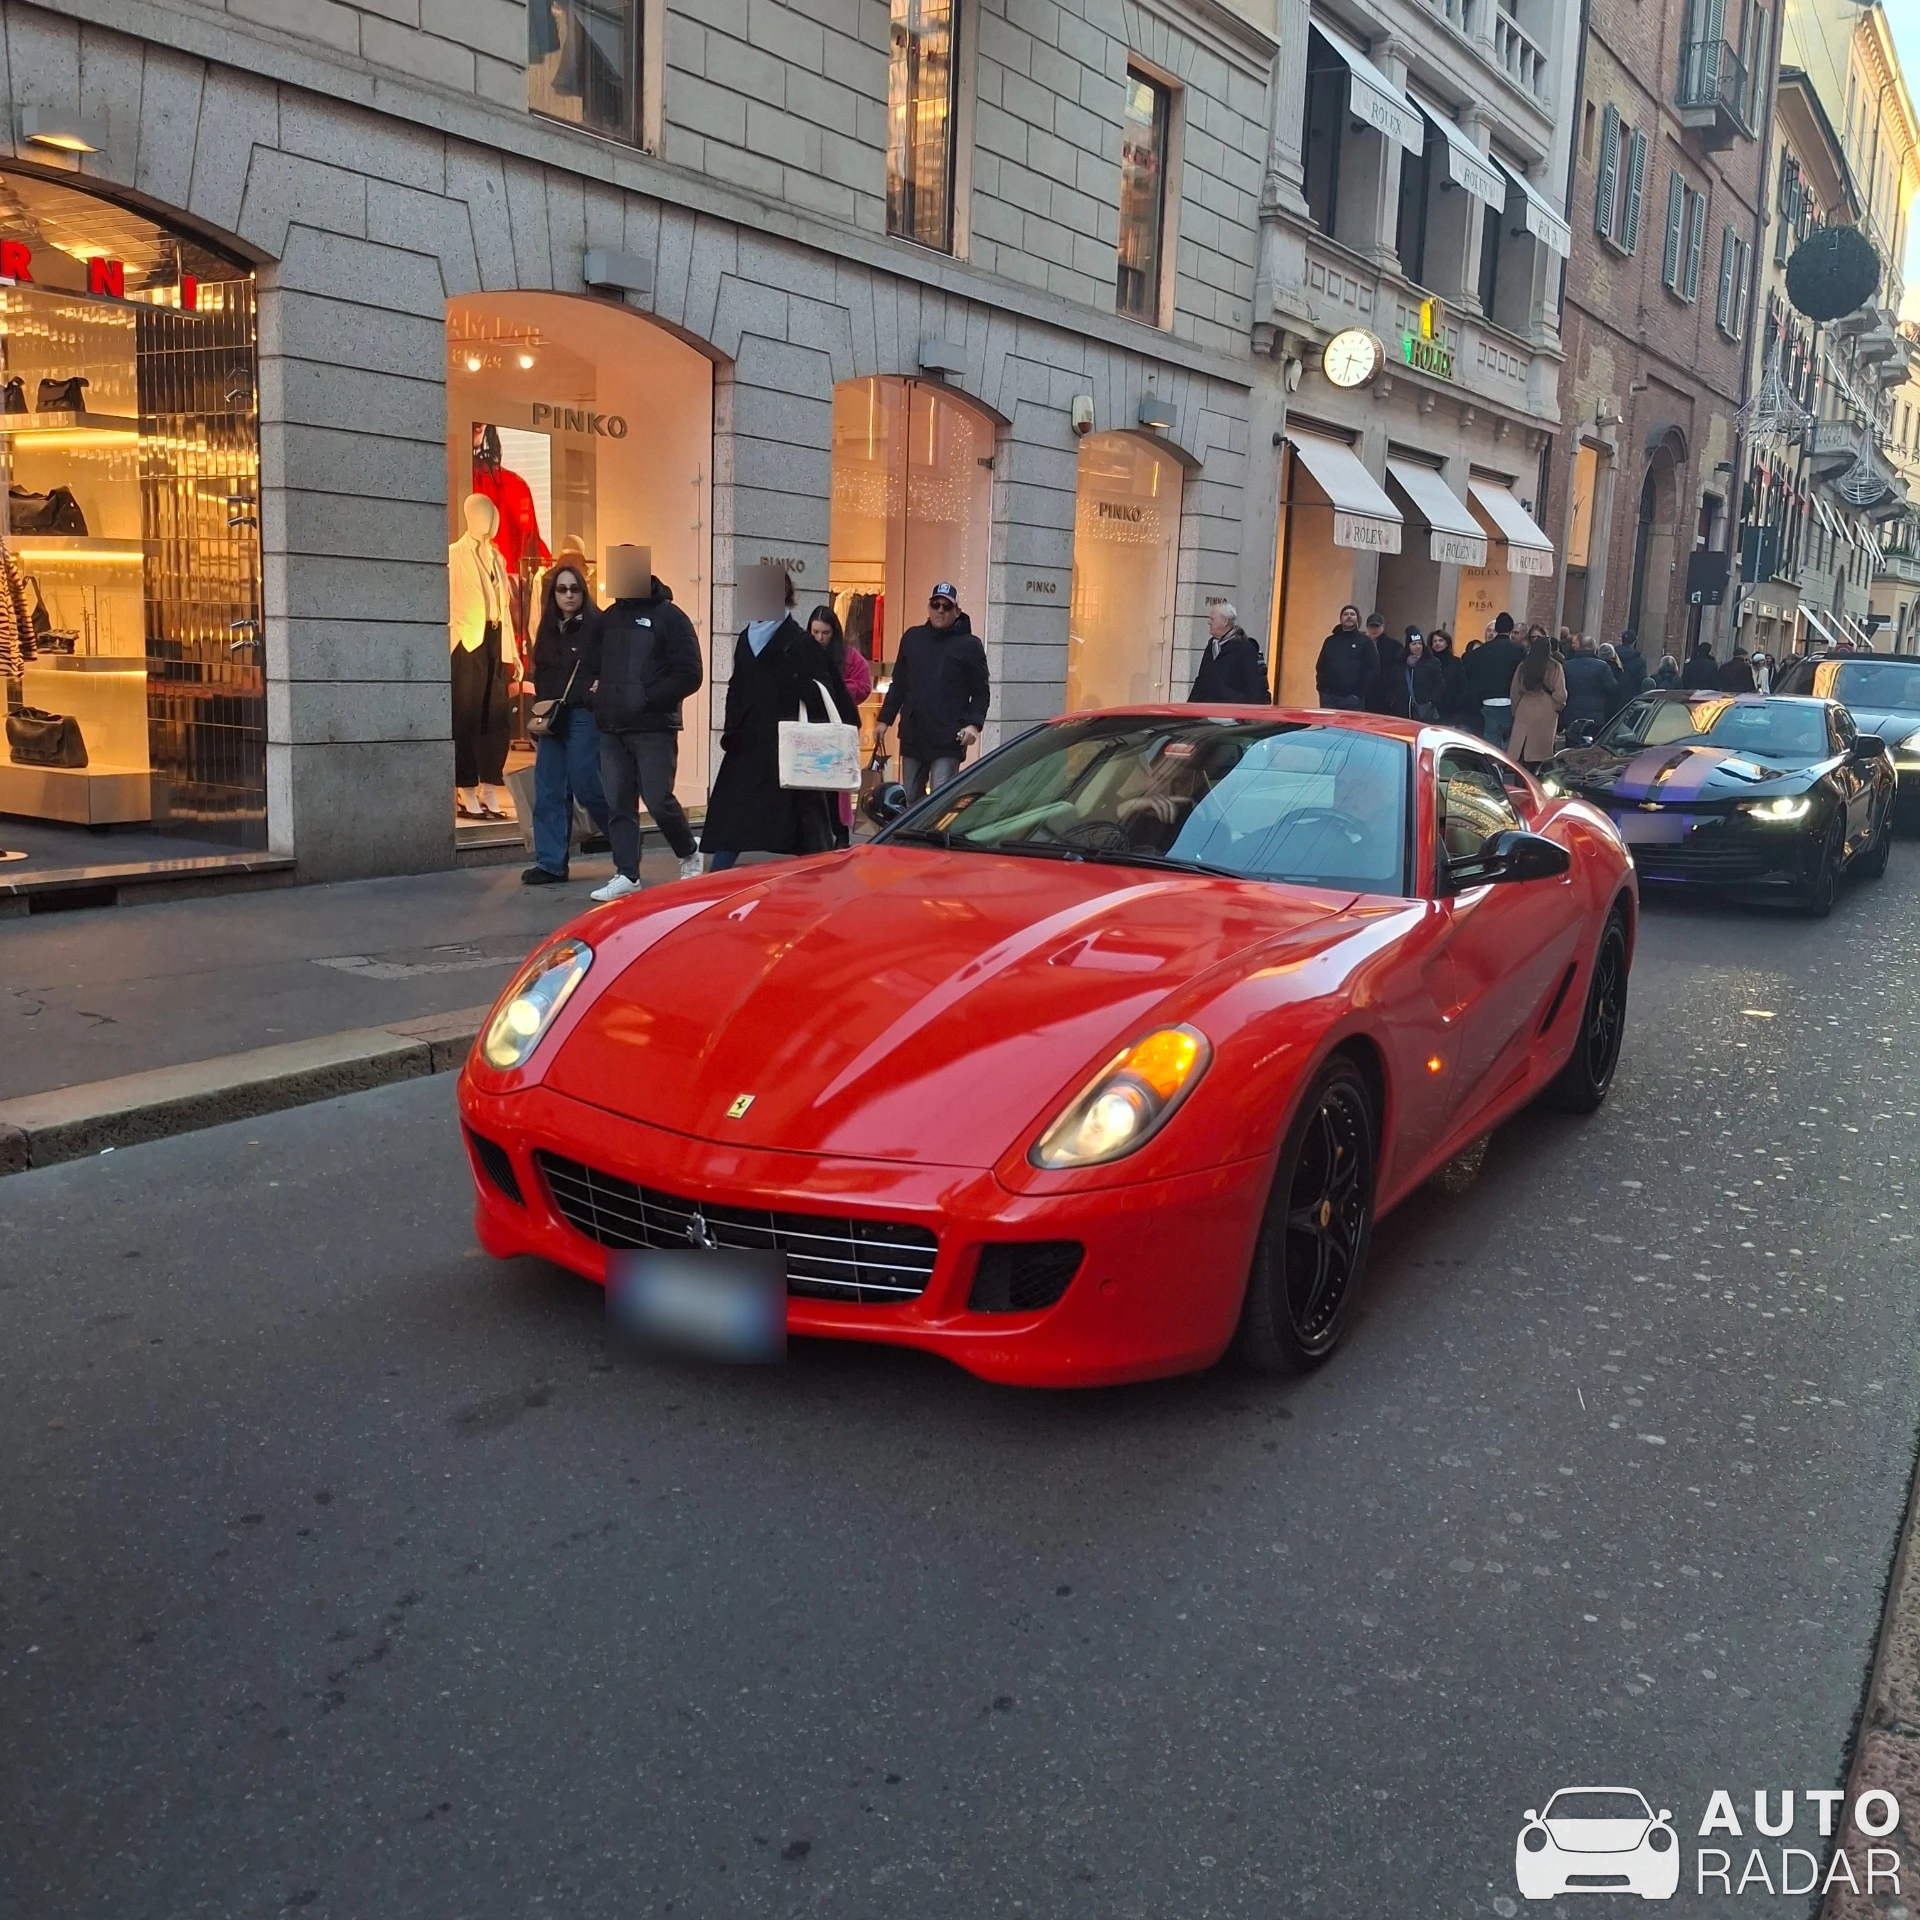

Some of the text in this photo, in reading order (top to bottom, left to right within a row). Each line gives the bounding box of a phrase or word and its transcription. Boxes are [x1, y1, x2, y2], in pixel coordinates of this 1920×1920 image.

[1371, 102, 1402, 134] ROLEX
[1464, 167, 1489, 196] ROLEX
[1409, 338, 1455, 379] ROLEX
[532, 402, 628, 439] PINKO
[1099, 502, 1142, 522] PINKO
[1353, 526, 1384, 545] ROLEX
[1446, 543, 1471, 560] ROLEX
[1467, 568, 1500, 577] ROLEX
[1025, 580, 1057, 594] PINKO
[1468, 600, 1494, 609] PISA
